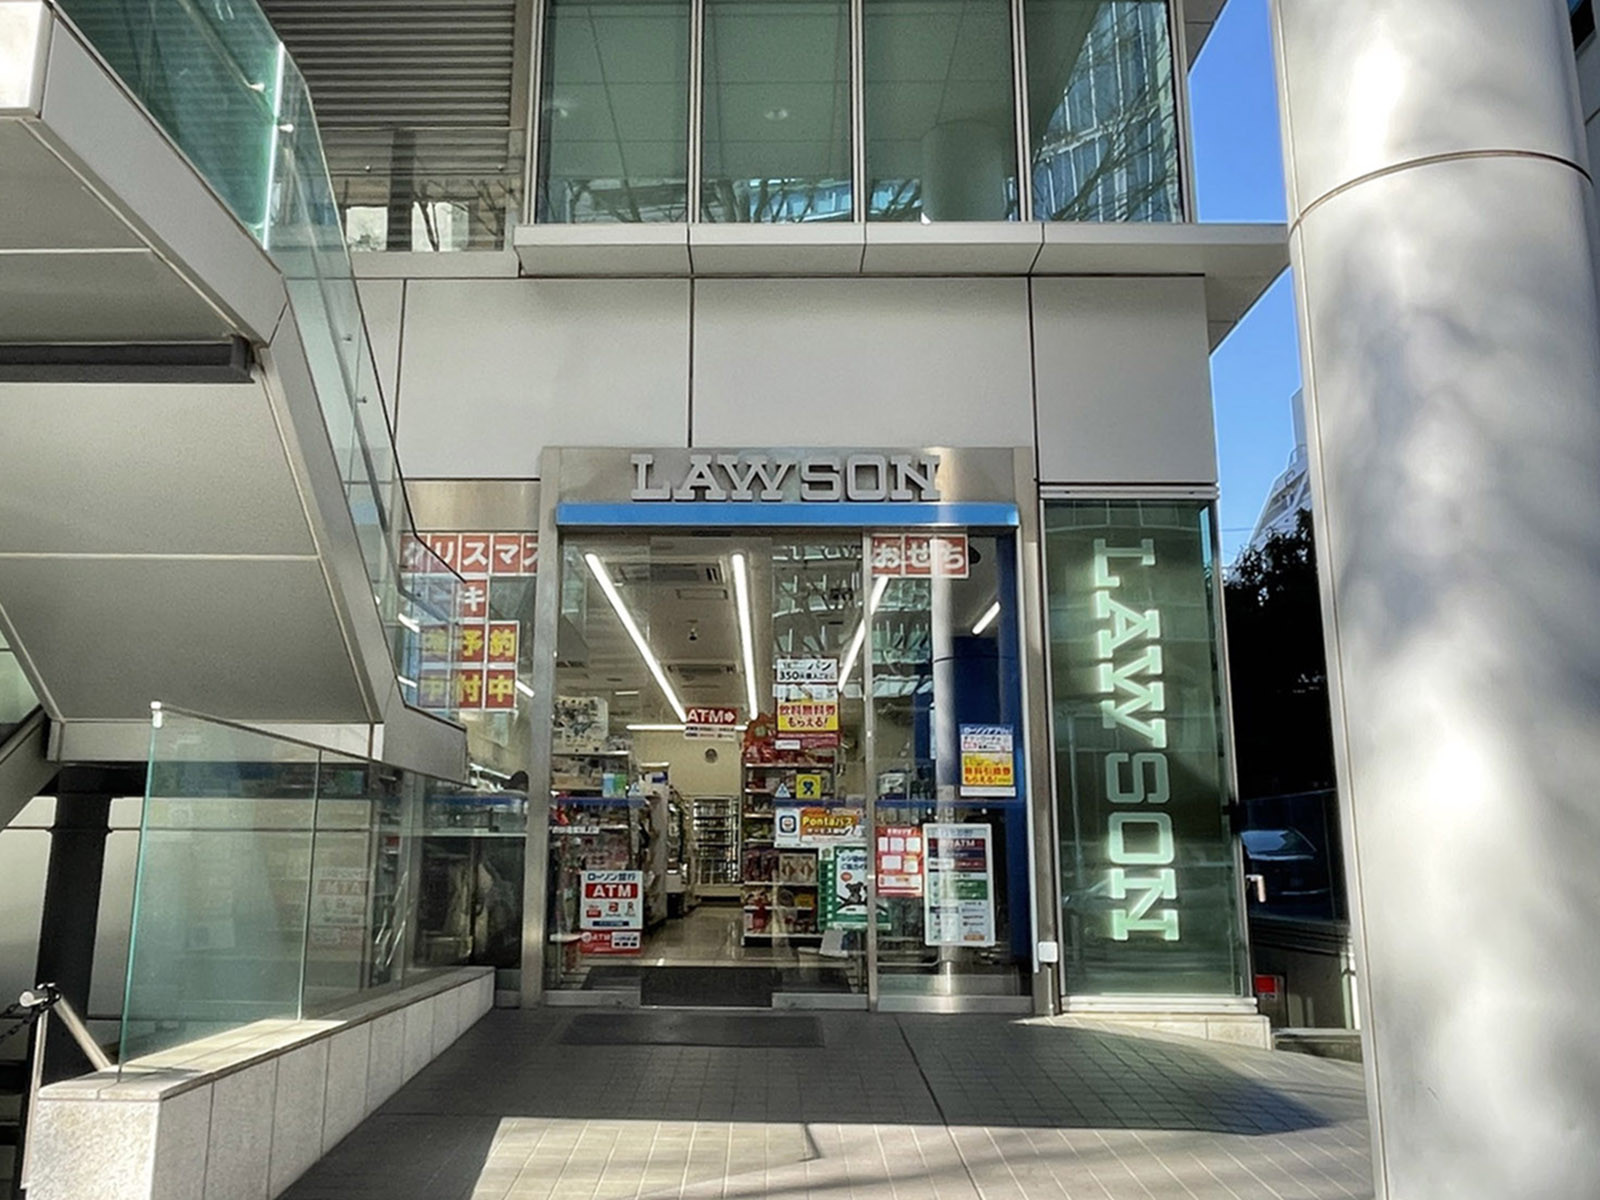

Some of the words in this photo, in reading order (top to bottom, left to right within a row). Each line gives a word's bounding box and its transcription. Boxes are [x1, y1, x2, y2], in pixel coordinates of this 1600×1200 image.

[630, 454, 942, 501] LAWSON
[873, 542, 965, 569] おせち
[687, 708, 725, 723] ATM
[1093, 538, 1180, 941] LAWSON
[592, 884, 632, 898] ATM
